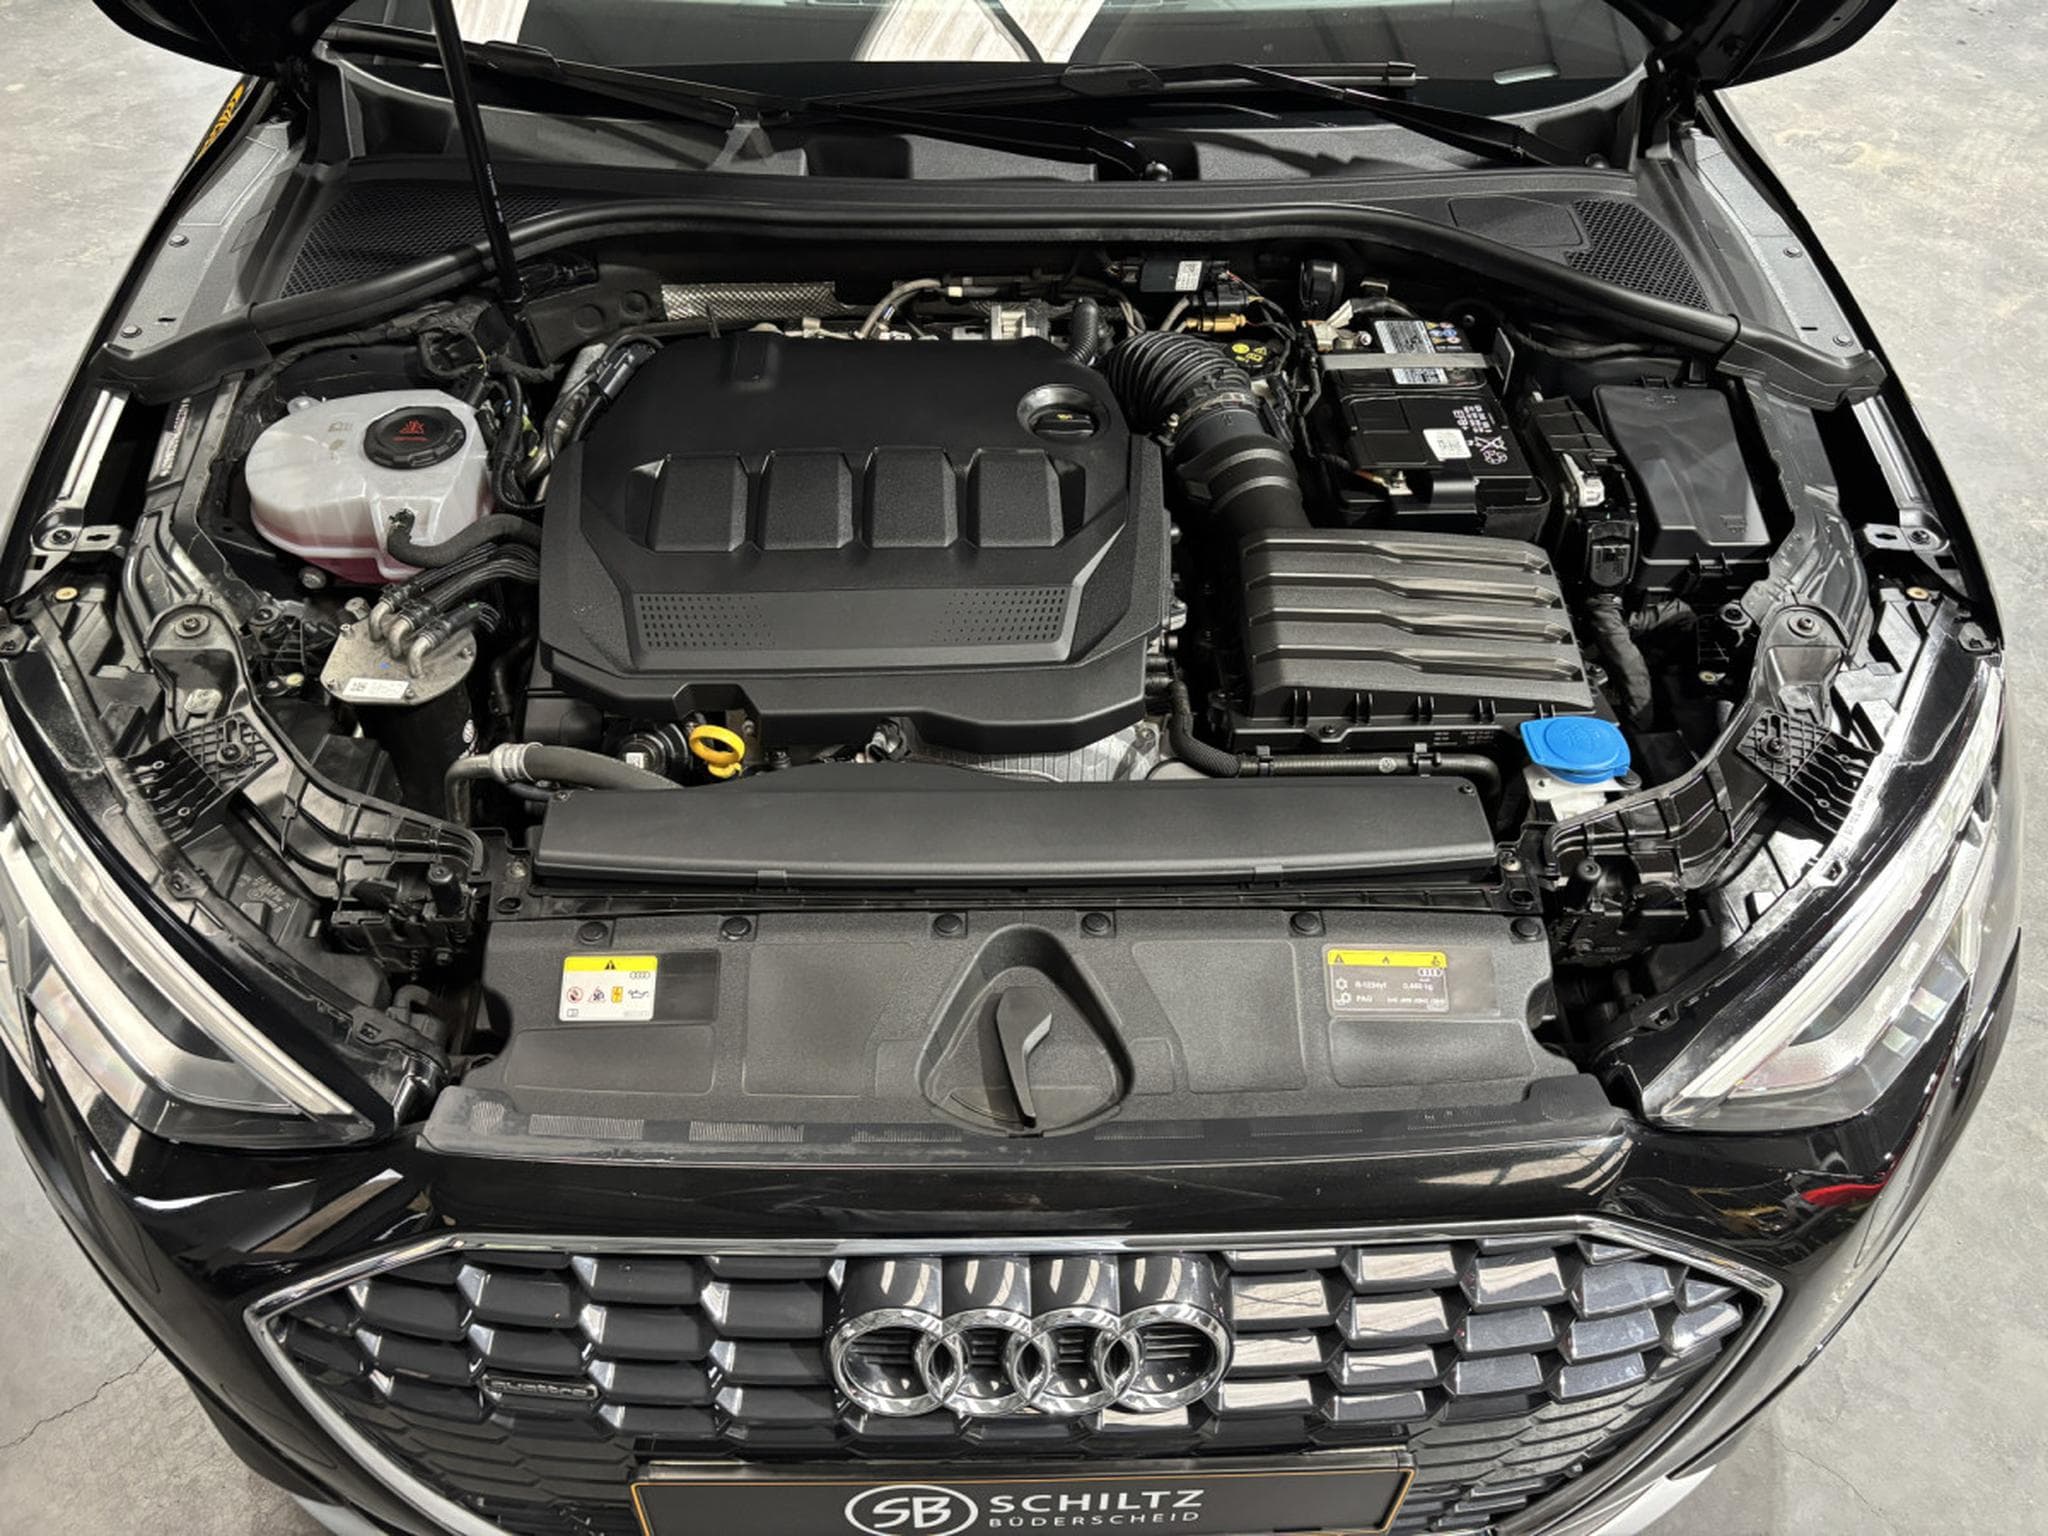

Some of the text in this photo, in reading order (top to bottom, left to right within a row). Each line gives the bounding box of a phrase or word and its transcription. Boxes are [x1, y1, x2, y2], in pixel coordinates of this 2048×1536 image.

[871, 1496, 952, 1529] SB
[989, 1489, 1205, 1514] SCHILTZ
[989, 1511, 1200, 1528] BÜDERSCHEID
